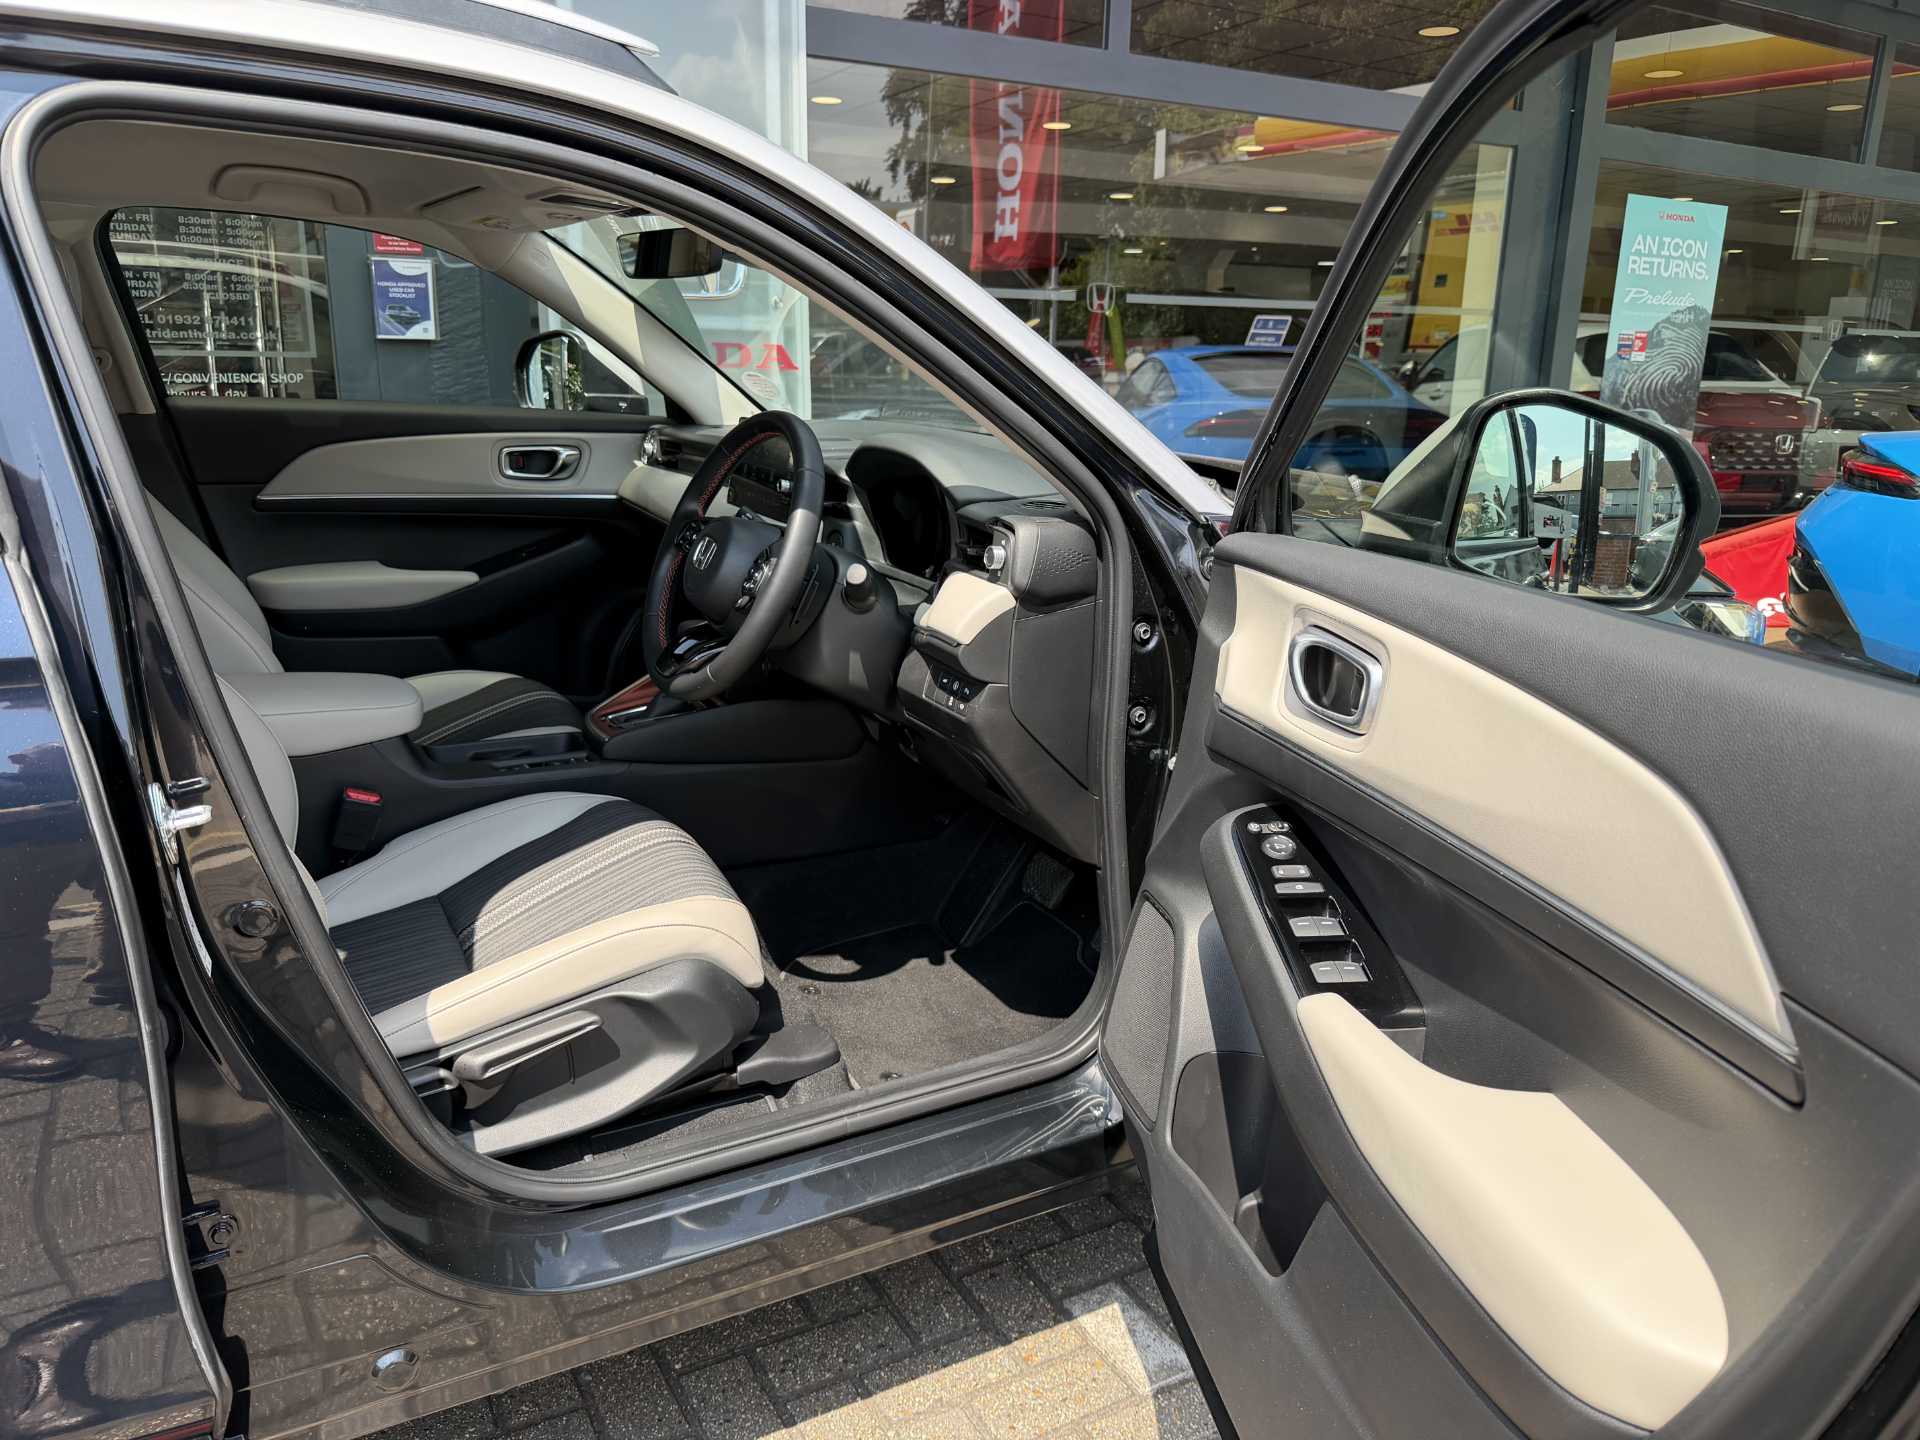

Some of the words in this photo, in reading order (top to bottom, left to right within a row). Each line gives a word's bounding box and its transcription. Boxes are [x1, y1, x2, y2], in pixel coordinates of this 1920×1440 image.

[178, 215, 217, 225] 8:30am
[1666, 213, 1696, 223] HONDA
[110, 222, 153, 232] TURDAY
[179, 226, 218, 235] 8:30am
[174, 234, 219, 244] 10:00am
[1631, 233, 1660, 255] AN
[1661, 236, 1709, 260] ICON
[1627, 255, 1710, 281] RETURNS.
[1623, 287, 1697, 308] Prelude
[157, 314, 200, 325] 01932
[270, 372, 304, 384] SHOP
